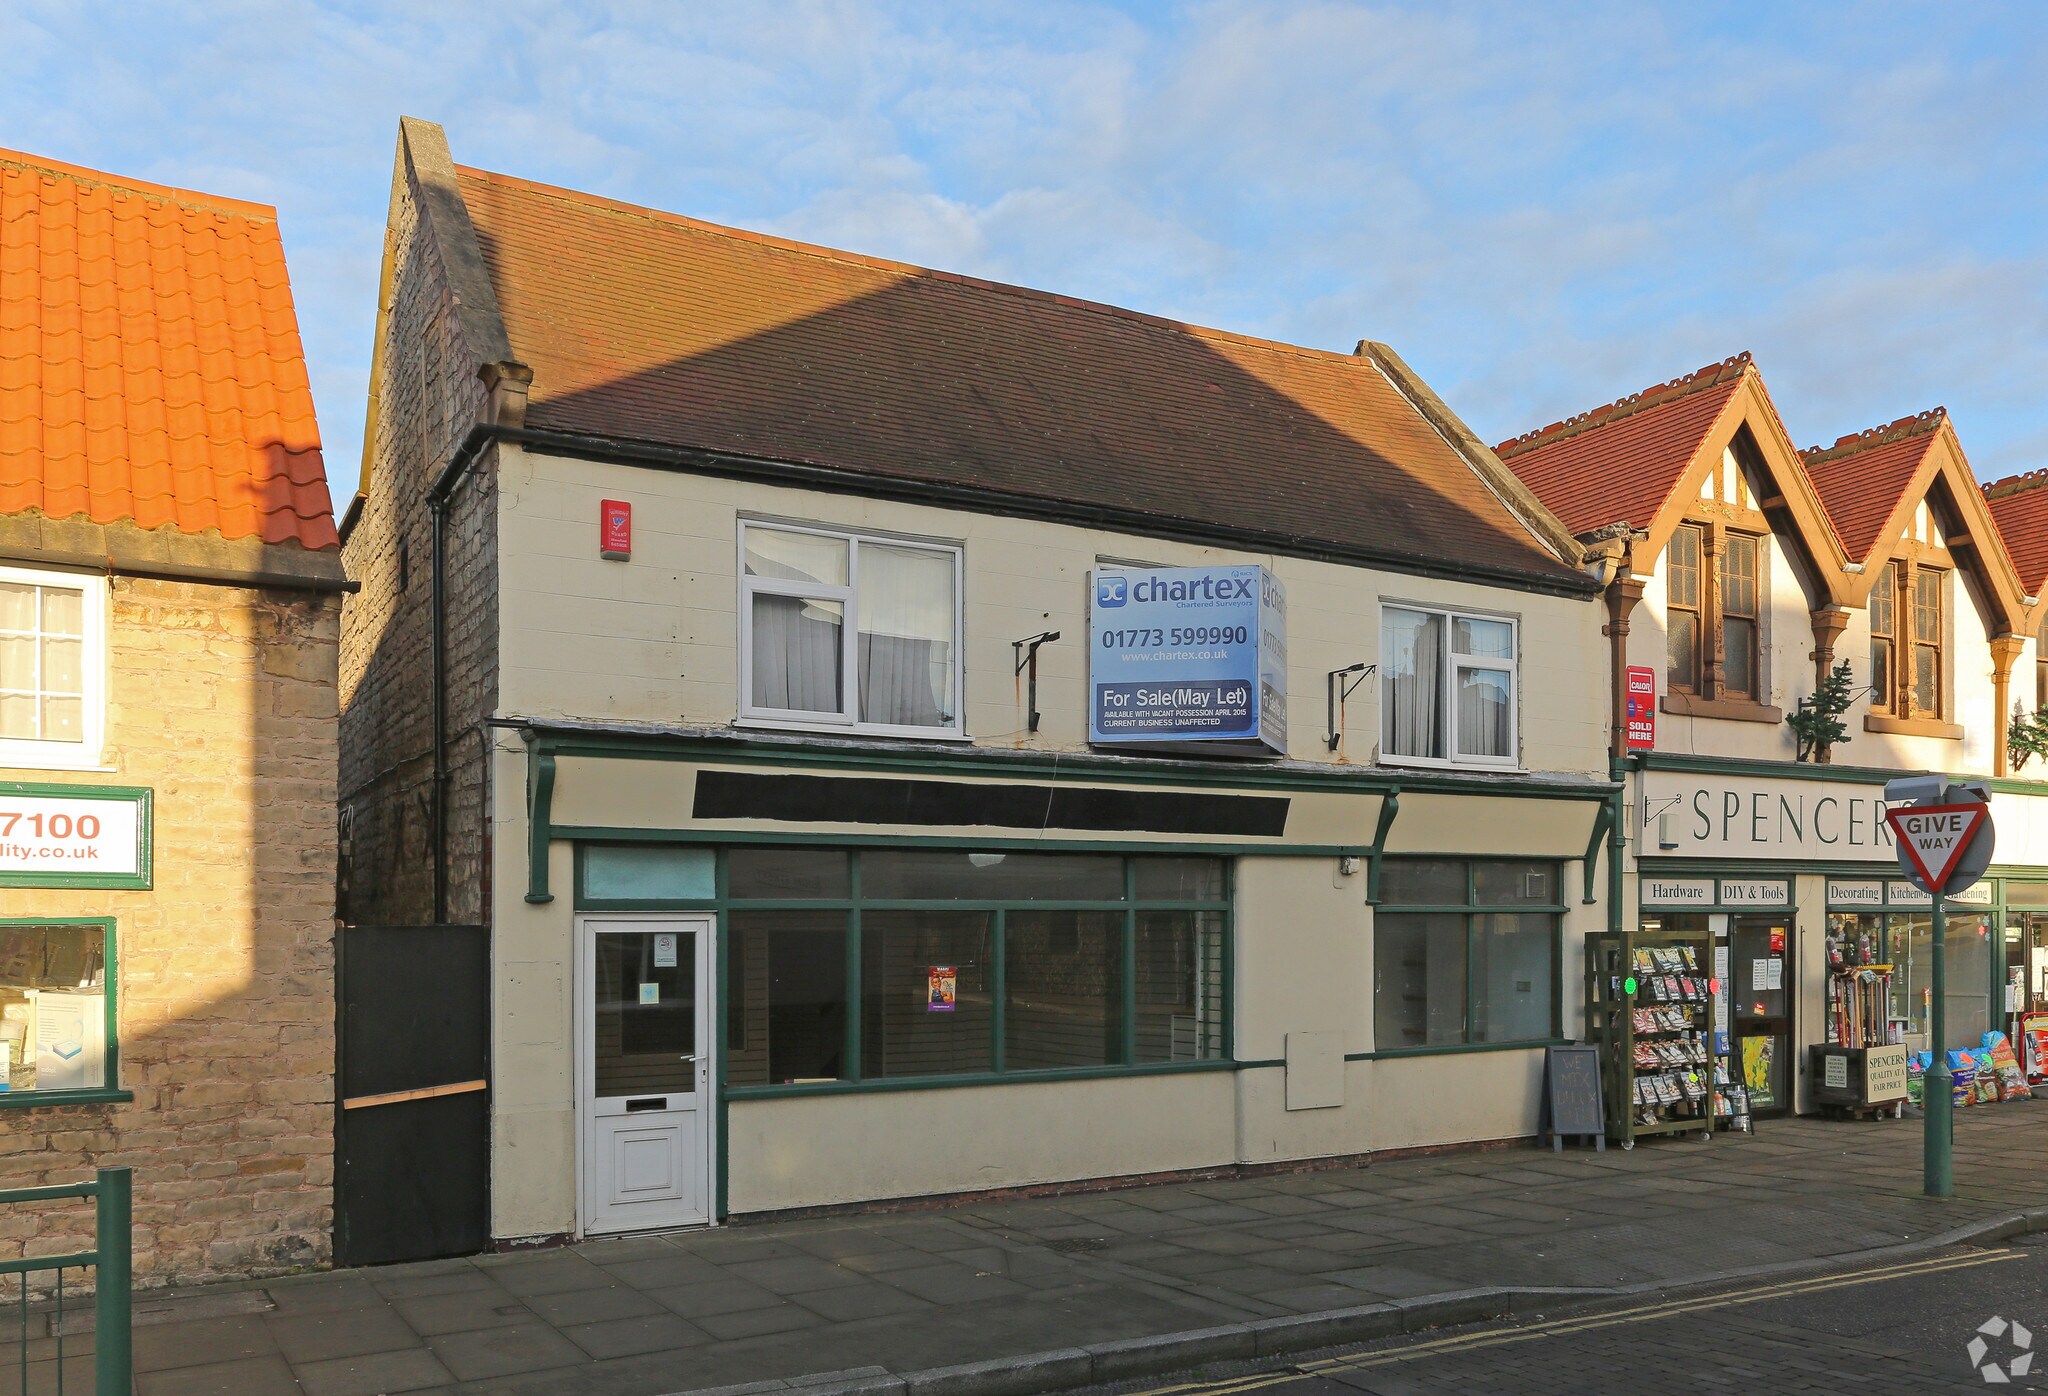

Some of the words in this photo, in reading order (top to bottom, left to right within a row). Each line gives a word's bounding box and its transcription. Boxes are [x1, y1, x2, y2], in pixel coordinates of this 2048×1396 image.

[1133, 575, 1252, 603] chartex
[1102, 629, 1164, 648] 01773
[1170, 626, 1247, 646] 599990
[1122, 649, 1228, 662] www.chartex.co.uk
[1631, 682, 1651, 692] CALOR
[1104, 690, 1131, 706] For
[1217, 687, 1247, 707] Let)
[1175, 718, 1220, 726] UNAFFECTED
[1629, 721, 1652, 731] SOLD
[1629, 731, 1652, 740] HERE
[1693, 789, 1914, 847] SPENCER
[1906, 815, 1962, 834] GIVE
[0, 812, 100, 839] 7100
[1919, 837, 1954, 849] WAY
[1652, 884, 1703, 898] Hardware
[1724, 885, 1746, 899] DIY
[1748, 886, 1757, 899] &
[1760, 886, 1784, 899] Tools
[1831, 885, 1879, 901] Decorating
[1562, 1055, 1584, 1070] WE
[1869, 1054, 1905, 1069] SPENCERS
[1870, 1071, 1893, 1081] QUALITY
[1873, 1083, 1886, 1091] FAIR
[1886, 1081, 1902, 1090] PRICE
